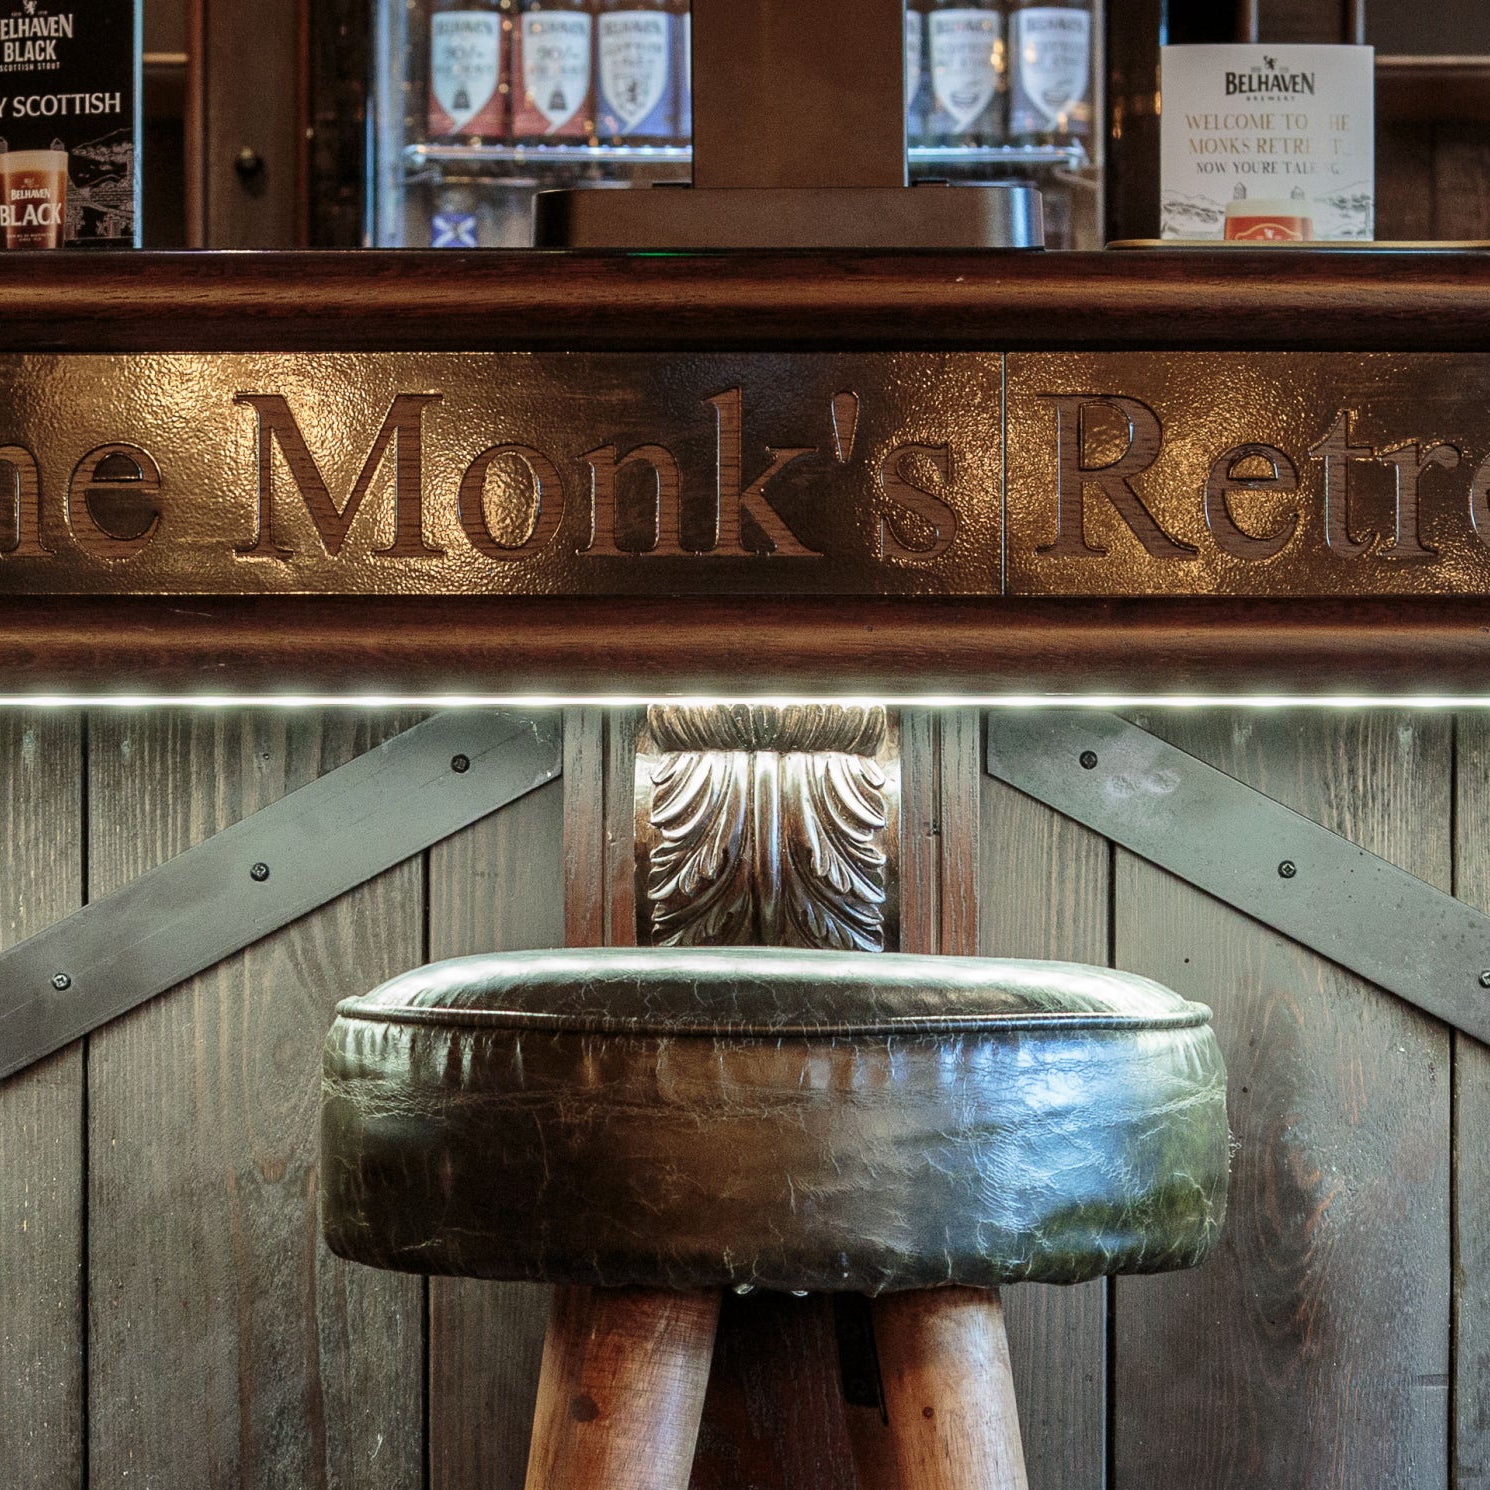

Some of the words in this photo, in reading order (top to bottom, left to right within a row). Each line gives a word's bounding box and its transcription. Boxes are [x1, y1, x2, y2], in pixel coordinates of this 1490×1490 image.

[4, 40, 56, 63] BLACK
[0, 64, 34, 73] SCOTTISH
[37, 62, 61, 71] STOUT
[1225, 72, 1315, 96] BELHAVEN
[13, 92, 121, 118] SCOTTISH
[1185, 114, 1276, 130] WELCOME
[1281, 114, 1308, 130] TO
[1189, 137, 1250, 155] MONKS
[1197, 161, 1226, 175] NOW
[11, 188, 50, 200] BELHAVEN
[0, 203, 61, 226] BLACK
[233, 386, 959, 560] Monk's
